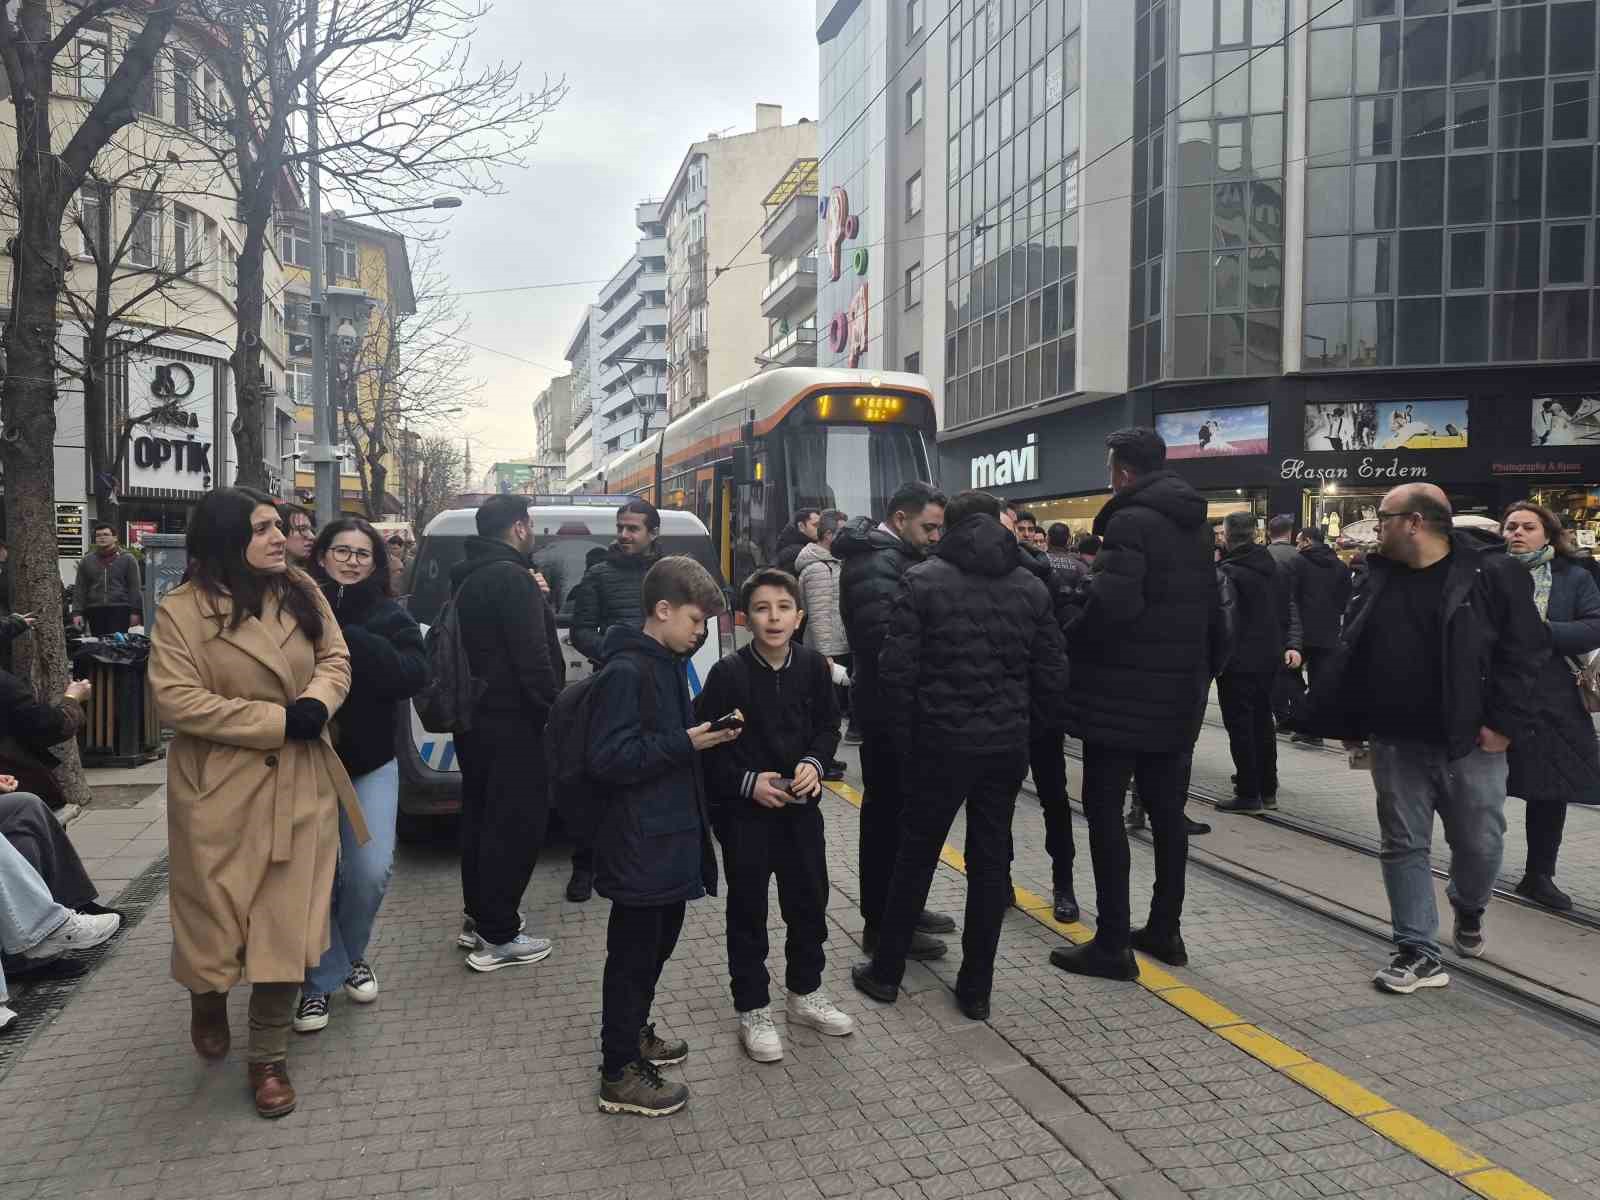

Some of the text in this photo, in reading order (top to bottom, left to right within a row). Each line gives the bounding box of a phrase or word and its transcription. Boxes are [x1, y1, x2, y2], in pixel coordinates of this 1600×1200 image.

[134, 434, 211, 474] OPTİK
[971, 432, 1037, 488] mavi
[1280, 456, 1428, 479] Hasan Erdem
[203, 476, 211, 488] 2
